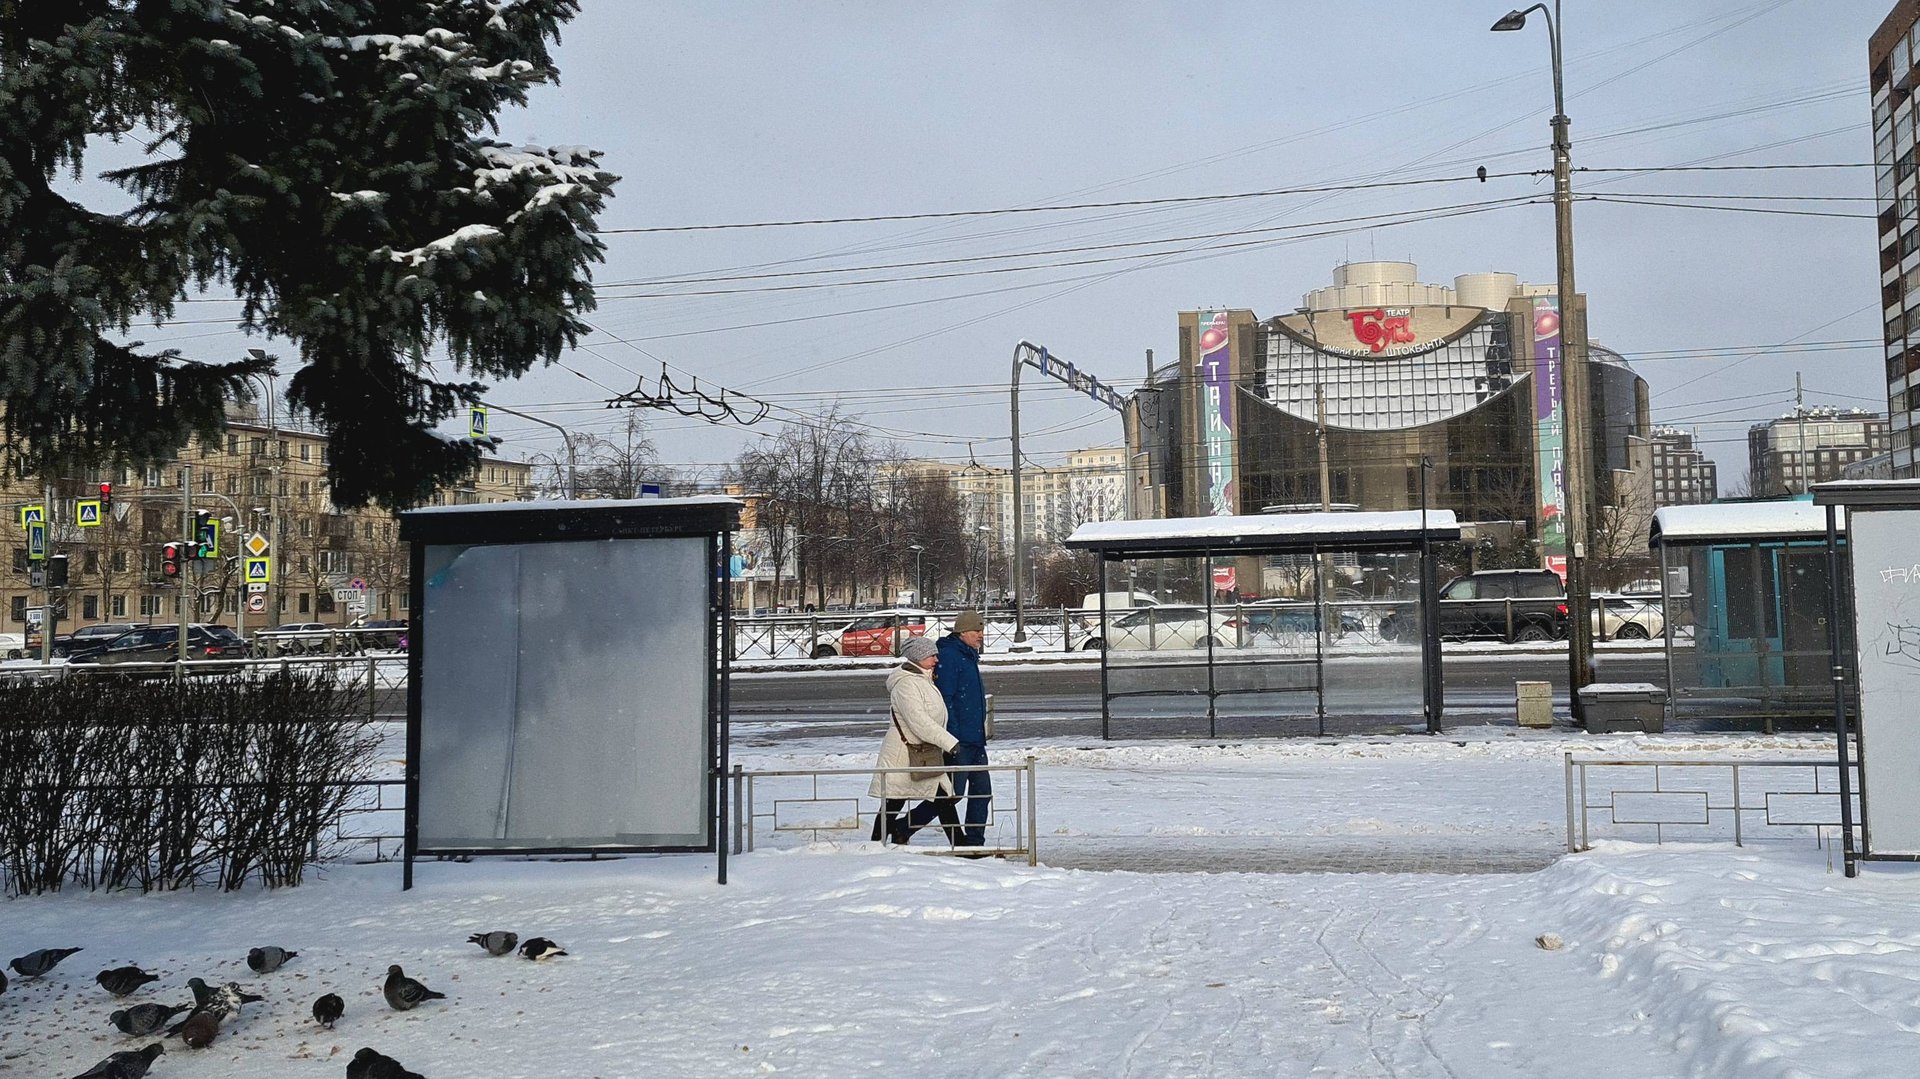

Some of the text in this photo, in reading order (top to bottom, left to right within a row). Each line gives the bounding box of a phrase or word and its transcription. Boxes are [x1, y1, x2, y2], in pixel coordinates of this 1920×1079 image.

[1386, 309, 1410, 317] ТЕАТР
[1385, 337, 1446, 357] ШТОКБАНТА
[1547, 347, 1559, 436] ТРЕТЬЕЙ
[1208, 361, 1221, 484] ТАЙНА
[1552, 446, 1565, 534] ПЛАНЕТЫ
[337, 590, 358, 600] СТОП
